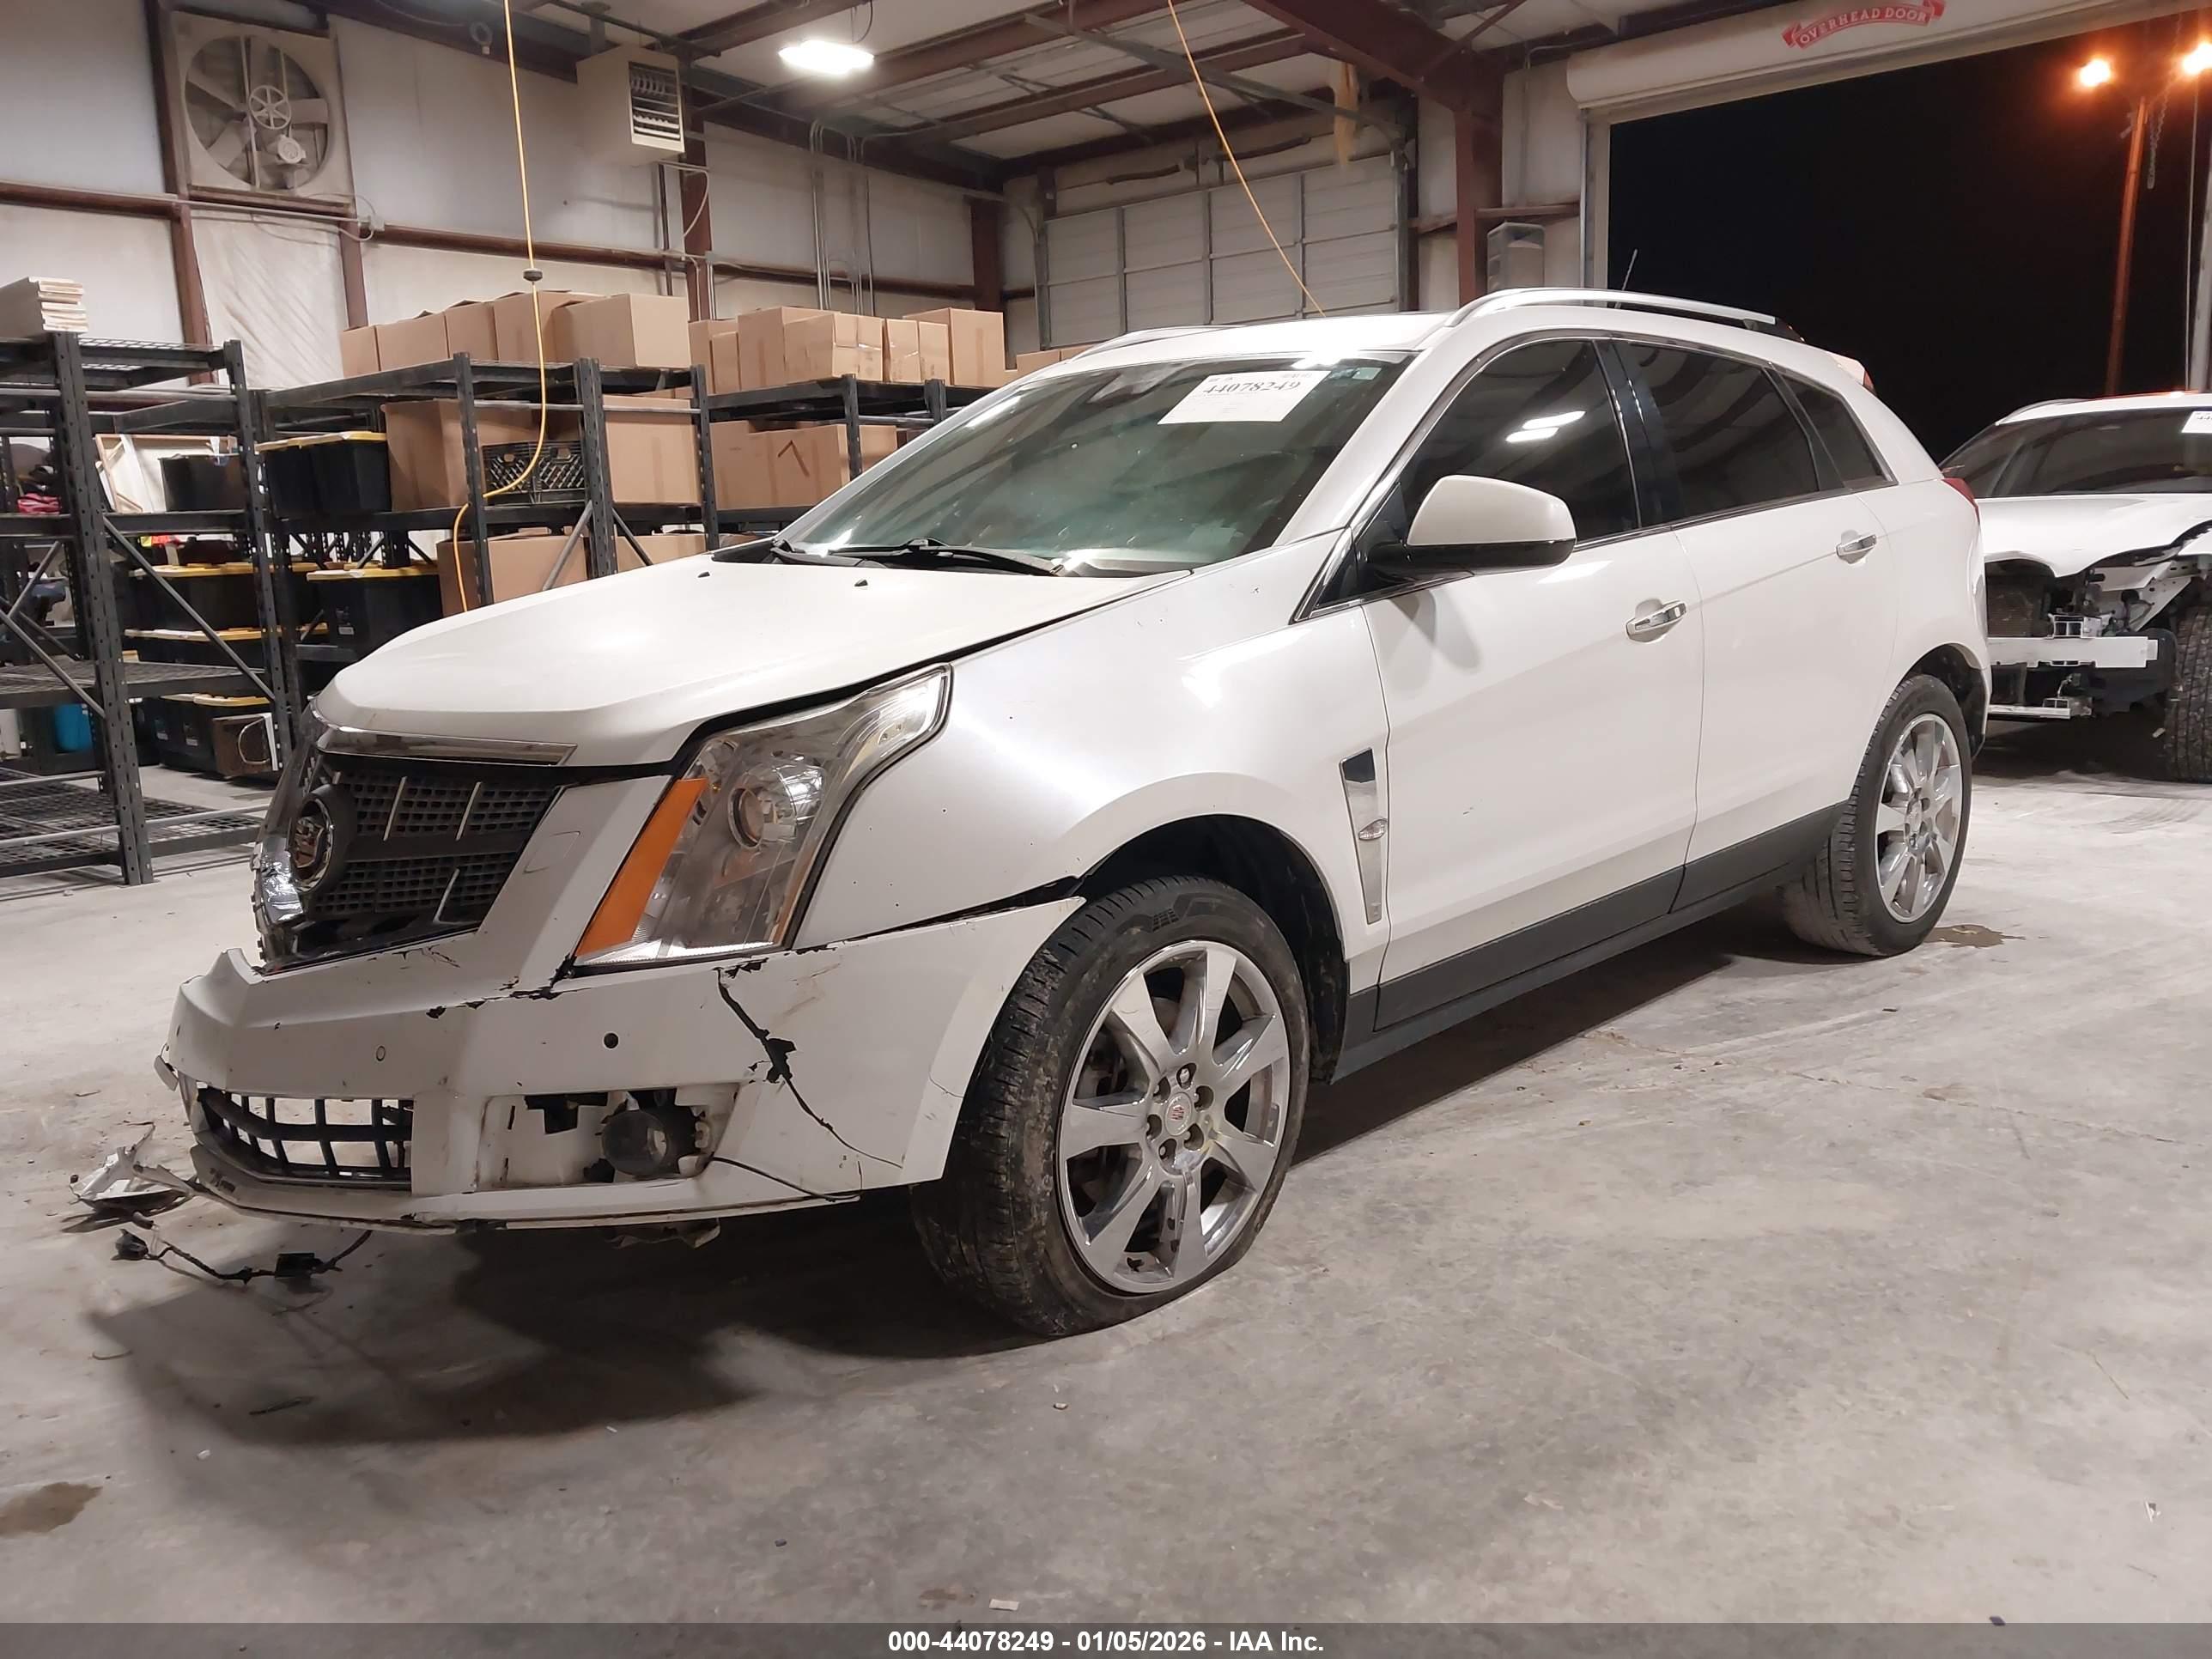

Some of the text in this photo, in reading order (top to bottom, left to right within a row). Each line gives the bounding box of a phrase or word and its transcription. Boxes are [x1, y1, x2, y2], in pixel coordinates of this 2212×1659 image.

[1800, 7, 1927, 44] OVERHEAD DOOR
[1203, 381, 1301, 393] 44078249
